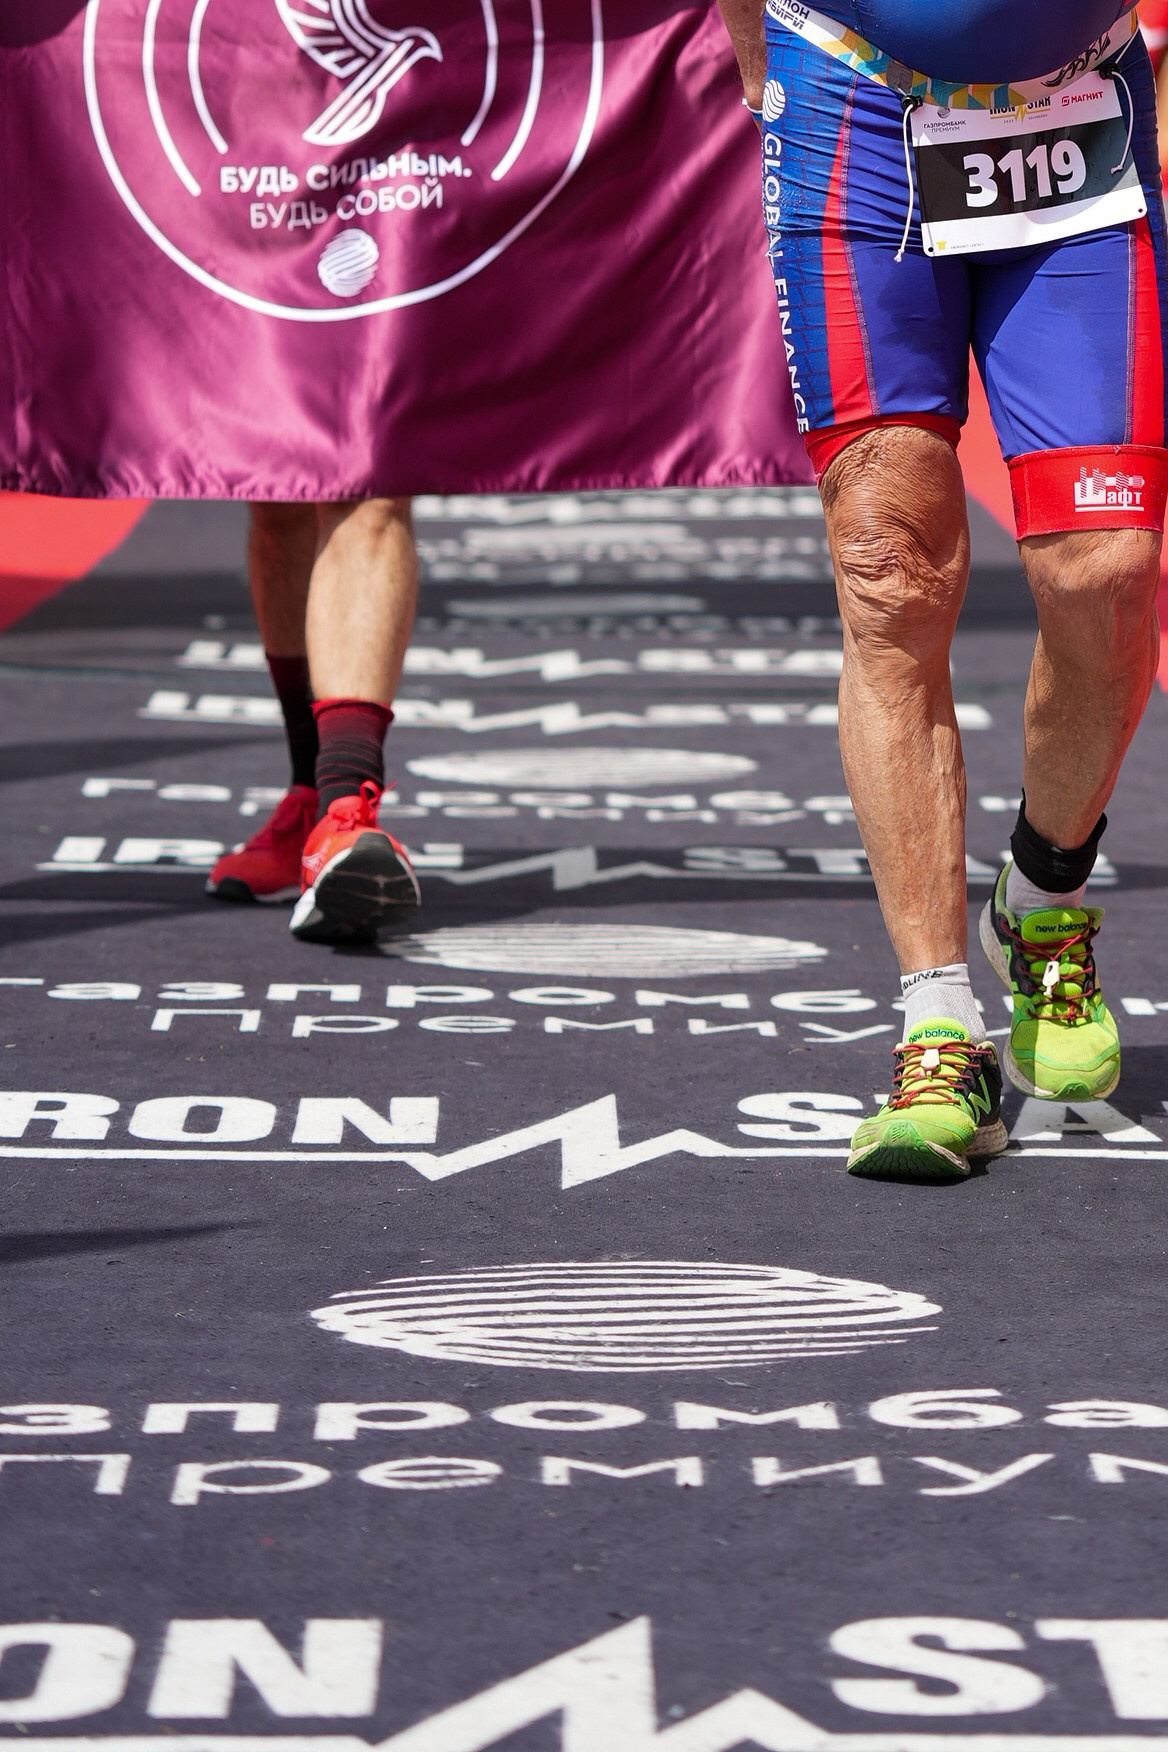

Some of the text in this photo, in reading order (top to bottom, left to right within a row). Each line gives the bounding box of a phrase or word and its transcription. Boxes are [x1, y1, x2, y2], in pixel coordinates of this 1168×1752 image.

[1071, 91, 1104, 104] МАГНИТ
[220, 165, 298, 196] БУДЬ
[963, 140, 1087, 208] 3119
[250, 178, 443, 230] БУДЬ СОБОЙ
[764, 132, 811, 435] GLOBAL FINANCE
[1036, 921, 1087, 933] new balance
[909, 1029, 965, 1044] new balance
